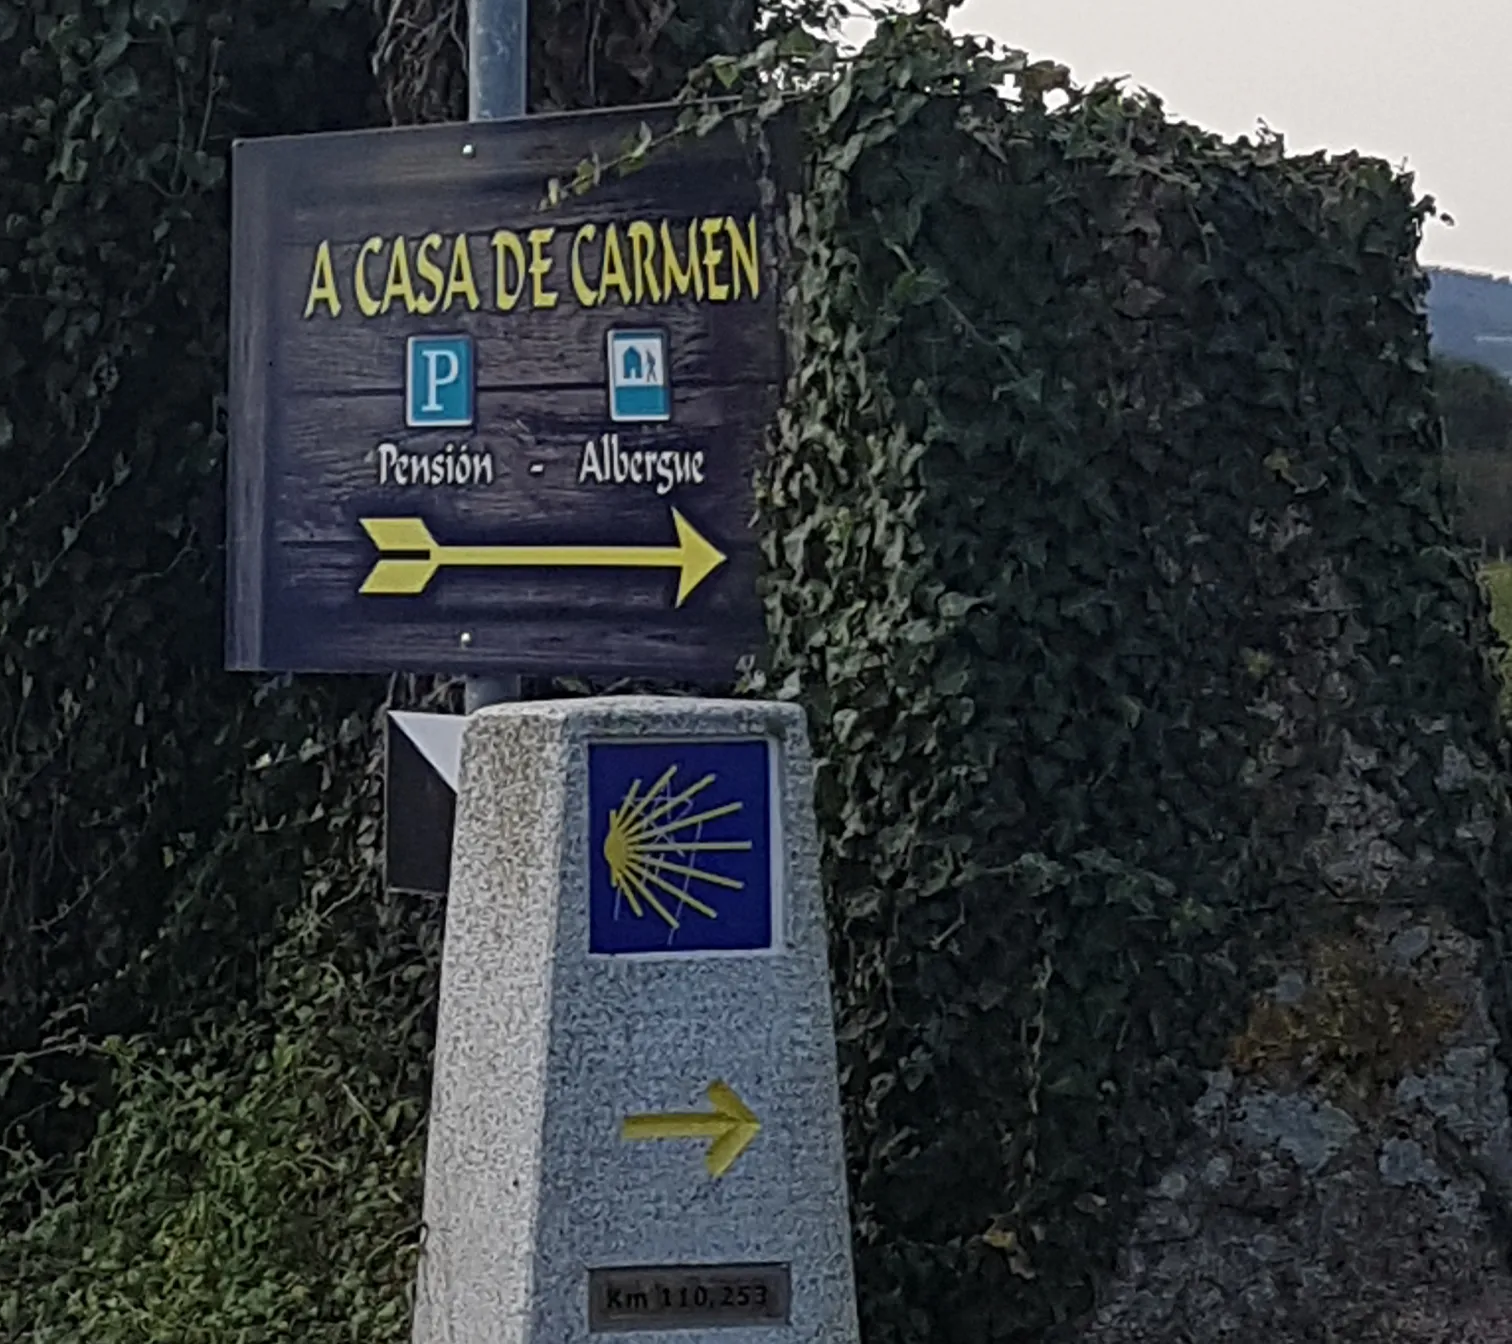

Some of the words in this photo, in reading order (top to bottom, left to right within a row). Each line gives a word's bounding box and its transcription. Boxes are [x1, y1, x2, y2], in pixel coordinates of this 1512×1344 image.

[304, 239, 342, 319] A
[354, 231, 480, 317] CASA
[491, 227, 559, 311] DE
[571, 213, 760, 307] CARMEN
[376, 440, 493, 486] Pensión
[578, 433, 704, 494] Albergue
